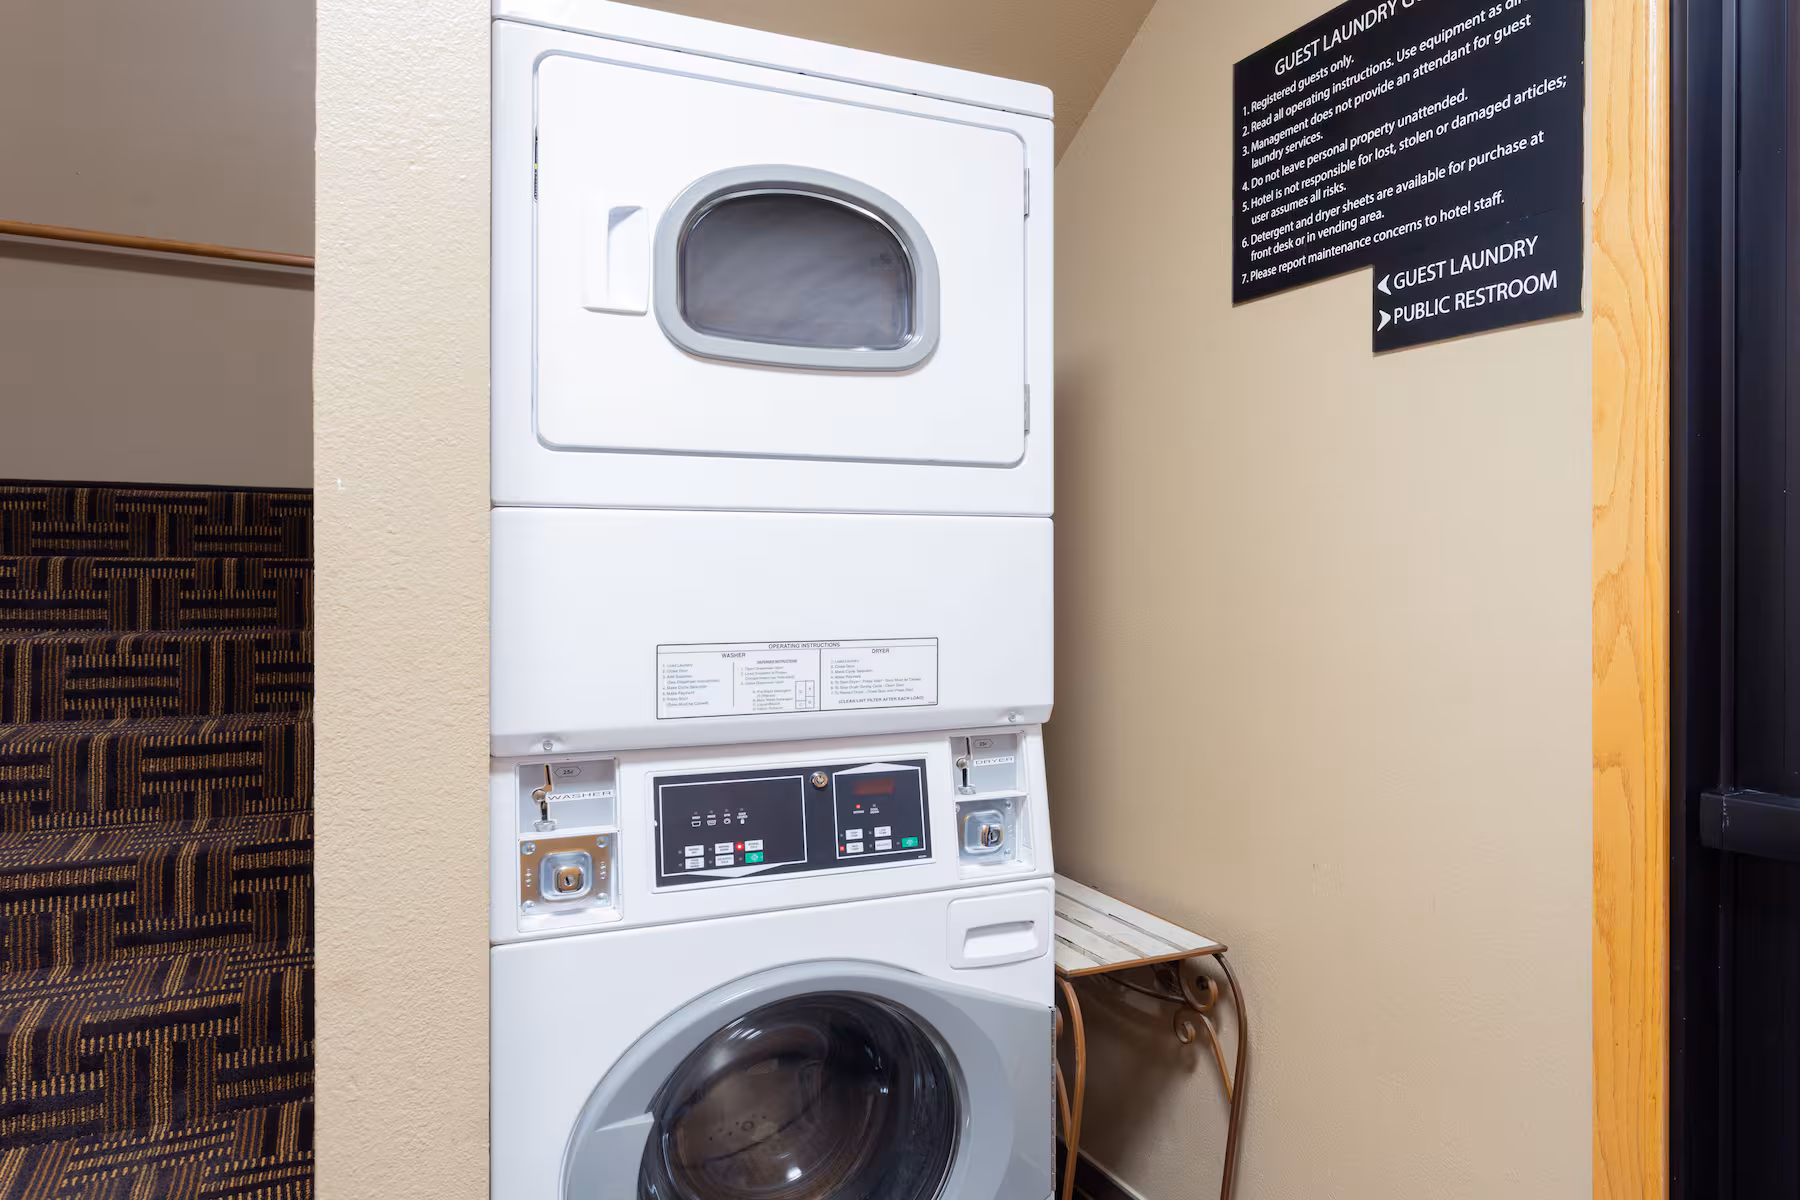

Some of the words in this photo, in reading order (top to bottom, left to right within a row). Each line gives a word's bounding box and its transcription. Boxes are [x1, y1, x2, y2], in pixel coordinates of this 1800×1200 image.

[1275, 38, 1320, 76] GUEST
[1323, 0, 1397, 52] LAUNDRY
[1242, 126, 1250, 137] 2.
[1251, 113, 1272, 132] Read
[1273, 107, 1284, 122] all
[1285, 88, 1330, 116] operating
[1332, 58, 1394, 94] instructions.
[1397, 46, 1417, 62] Use
[1419, 10, 1486, 51] equipment
[1488, 3, 1502, 18] as
[1242, 146, 1250, 156] 3.
[1251, 118, 1309, 153] Management
[1310, 108, 1333, 125] does
[1335, 98, 1352, 114] not
[1354, 79, 1394, 109] provide
[1396, 73, 1410, 86] an
[1413, 42, 1471, 79] attendant
[1473, 34, 1491, 51] for
[1494, 14, 1531, 44] guest
[1243, 106, 1250, 116] 1.
[1251, 80, 1296, 112] Registered
[1298, 67, 1328, 92] guests
[1330, 55, 1354, 73] only.
[1242, 181, 1250, 191] 4.
[1251, 177, 1264, 189] Do
[1265, 168, 1280, 183] not
[1282, 160, 1305, 176] leave
[1307, 138, 1348, 168] personal
[1350, 121, 1395, 151] property
[1397, 88, 1468, 128] unattended.
[1242, 201, 1249, 212] 5.
[1251, 190, 1274, 209] Hotel
[1275, 189, 1282, 199] is
[1284, 181, 1300, 196] not
[1301, 159, 1356, 189] responsible
[1358, 153, 1373, 167] for
[1375, 143, 1397, 160] lost,
[1399, 129, 1433, 151] stolen
[1436, 122, 1449, 135] or
[1451, 94, 1511, 129] damaged
[1514, 75, 1567, 105] articles;
[1252, 148, 1284, 169] laundry
[1285, 131, 1323, 154] services.
[1242, 237, 1249, 248] 6.
[1251, 221, 1294, 245] Detergent
[1295, 212, 1313, 229] and
[1315, 206, 1341, 222] dryer
[1342, 194, 1375, 213] sheets
[1376, 187, 1394, 201] are
[1396, 167, 1446, 194] available
[1448, 160, 1466, 175] for
[1468, 139, 1527, 171] purchase
[1530, 130, 1544, 146] at
[1251, 211, 1270, 225] user
[1271, 196, 1308, 218] assumes
[1310, 188, 1321, 203] all
[1323, 182, 1346, 198] risks.
[1242, 273, 1249, 284] 7.
[1250, 266, 1277, 281] Please
[1278, 255, 1306, 273] report
[1308, 236, 1371, 264] maintenance
[1373, 219, 1422, 243] concerns
[1424, 215, 1437, 227] to
[1440, 200, 1471, 222] hotel
[1474, 190, 1505, 212] staff.
[1251, 246, 1272, 261] front
[1273, 238, 1294, 254] desk
[1295, 236, 1305, 246] or
[1307, 232, 1316, 243] in
[1318, 218, 1357, 239] vending
[1360, 210, 1384, 225] area.
[1394, 260, 1447, 289] GUEST
[1450, 235, 1538, 275] LAUNDRY
[1394, 295, 1450, 324] PUBLIC
[1455, 270, 1557, 311] RESTROOM
[976, 757, 1013, 765] DRYER
[548, 791, 612, 801] WASHER
